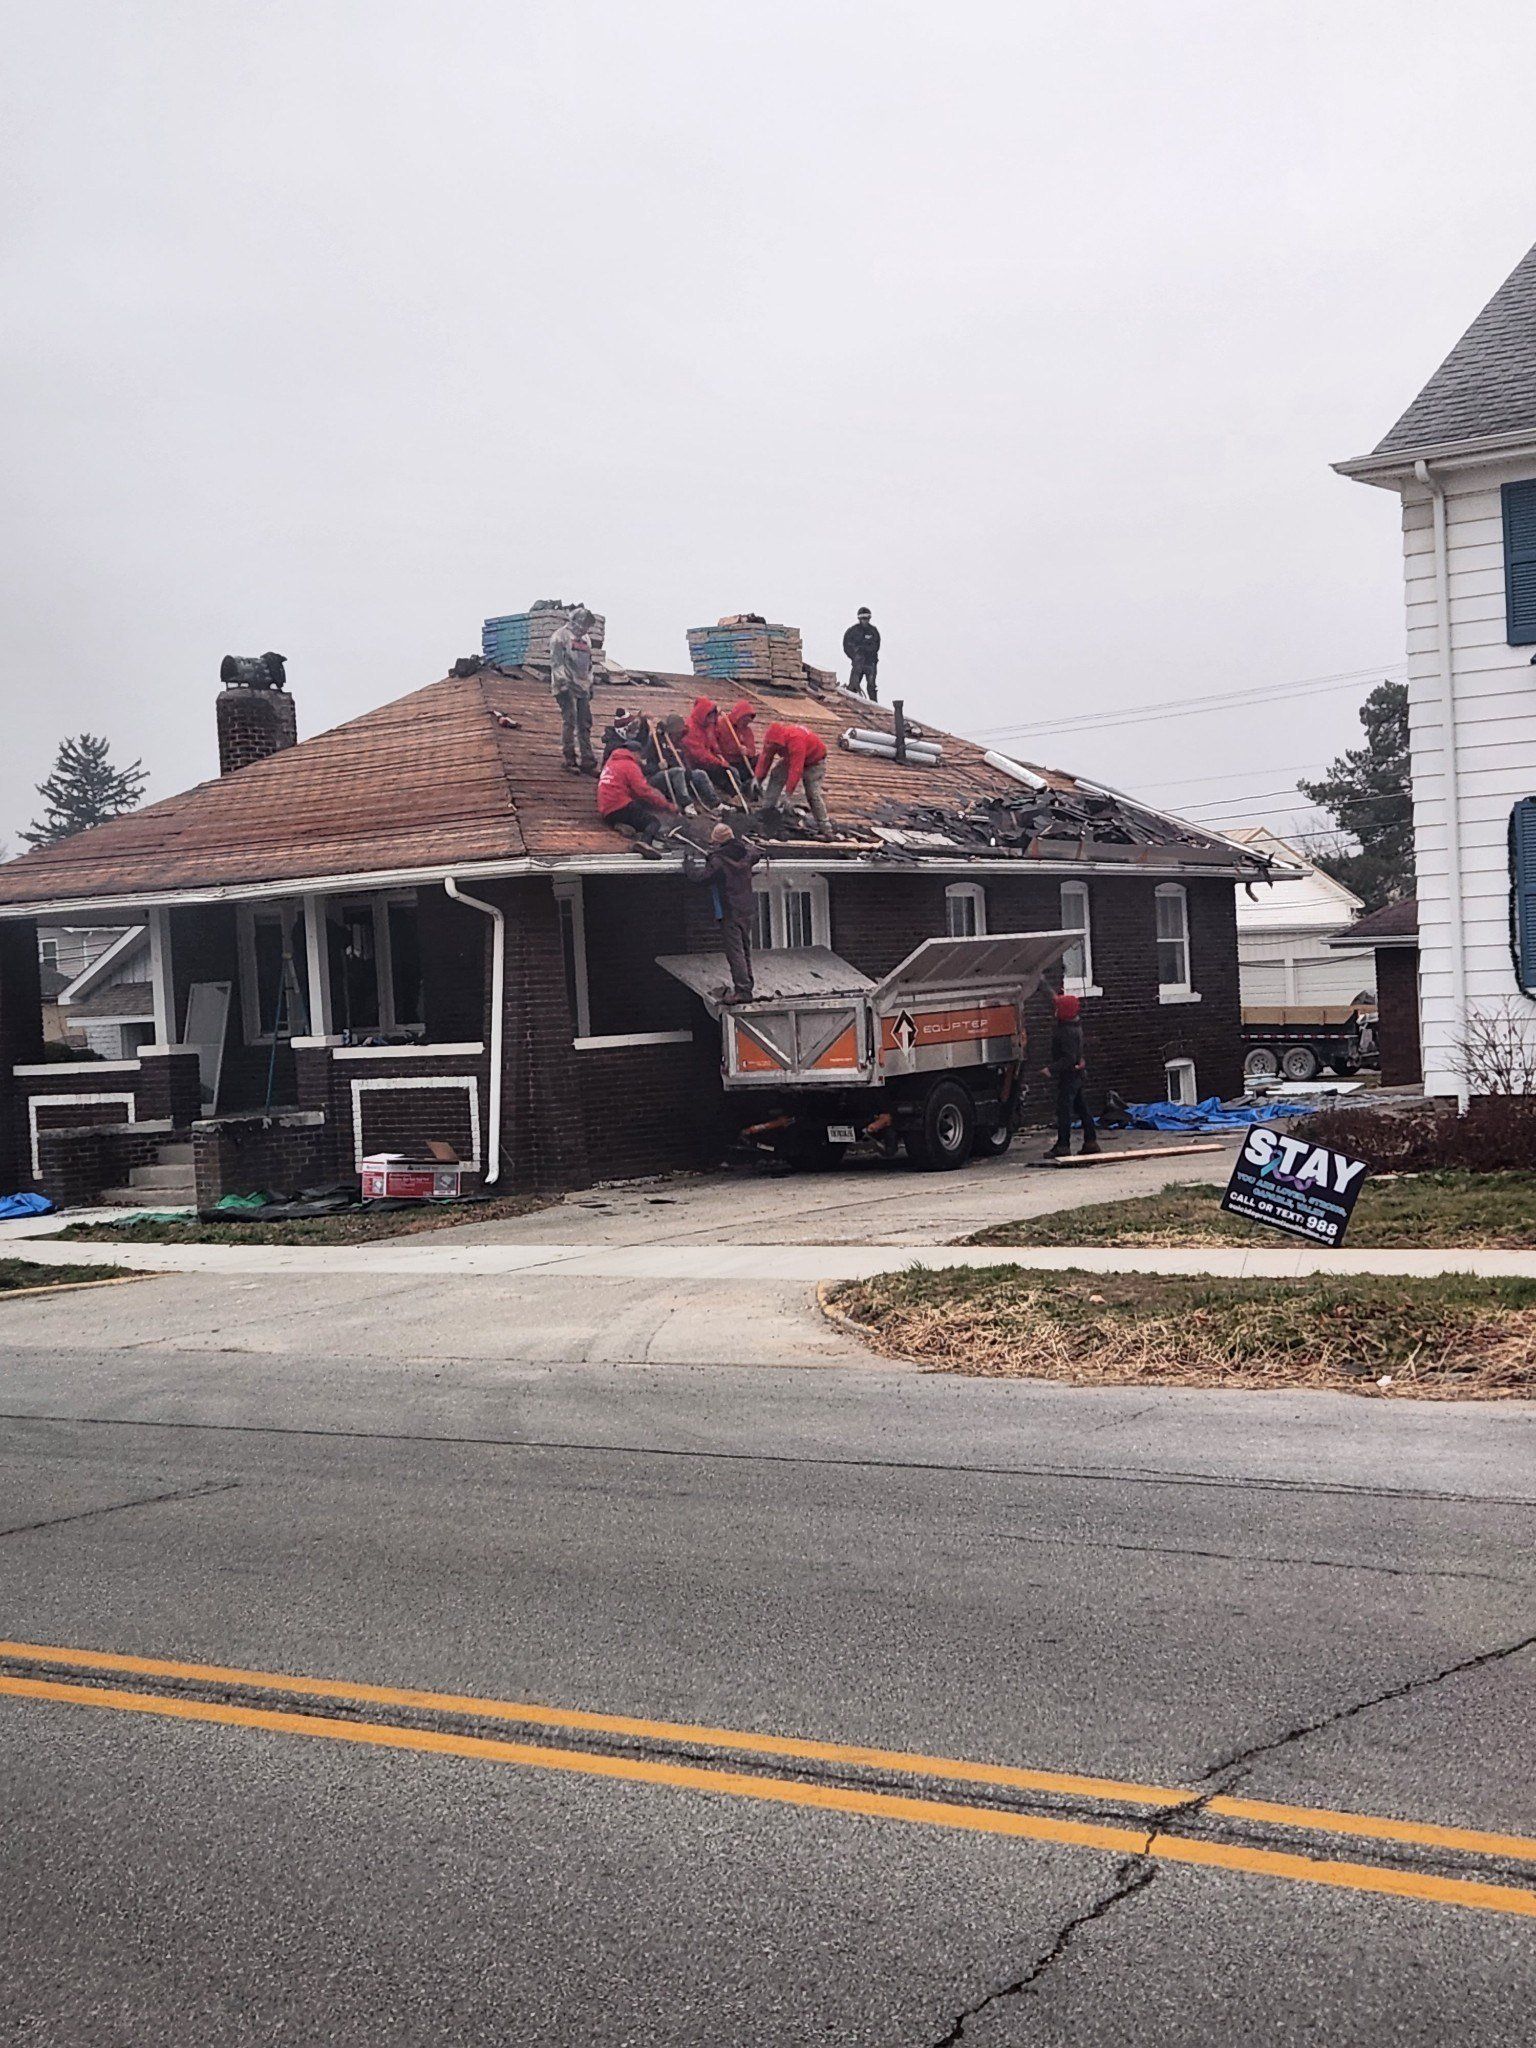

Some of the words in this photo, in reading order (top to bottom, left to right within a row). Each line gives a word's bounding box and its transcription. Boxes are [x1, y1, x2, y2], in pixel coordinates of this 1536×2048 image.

[1244, 1128, 1367, 1194] STAY
[1229, 1191, 1256, 1207] CALL
[1258, 1201, 1274, 1213] OR
[1275, 1206, 1305, 1223] TEXT:
[1306, 1216, 1339, 1236] 988
